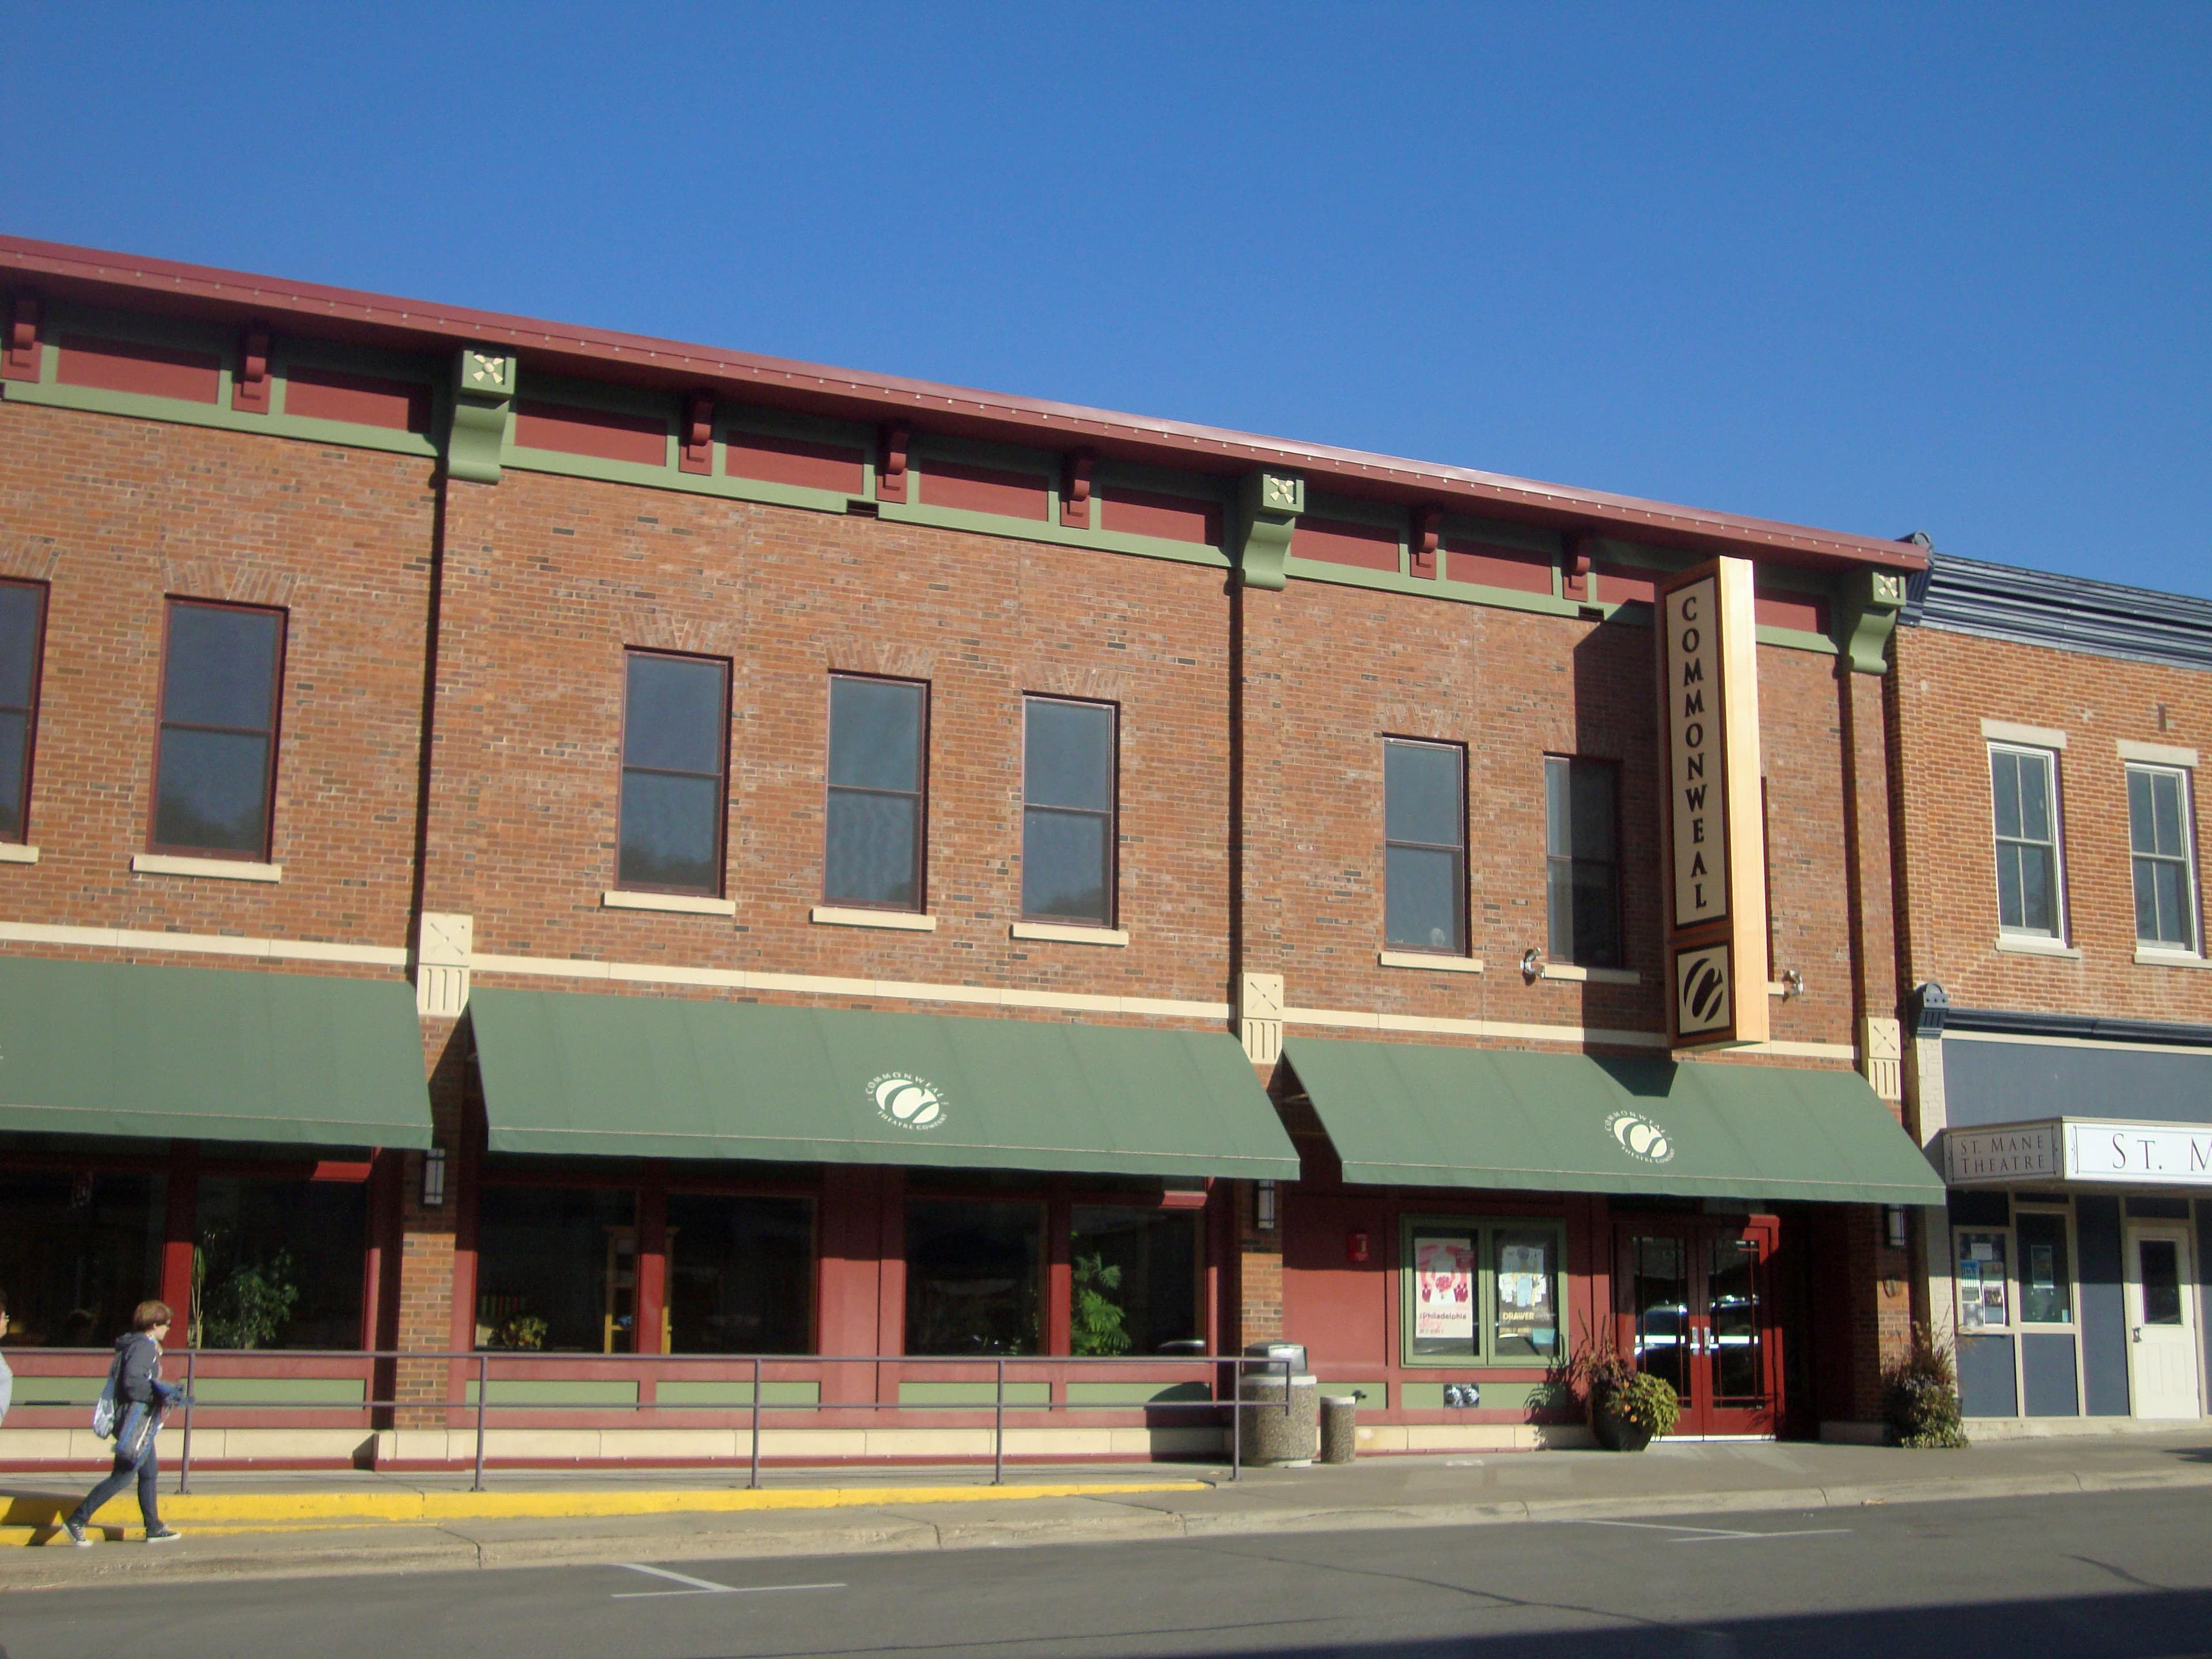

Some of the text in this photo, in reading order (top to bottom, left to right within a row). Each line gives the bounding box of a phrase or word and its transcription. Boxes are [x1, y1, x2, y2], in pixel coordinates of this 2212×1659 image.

[1681, 596, 1709, 910] COMMONWEAL
[1991, 1133, 2043, 1153] MANE
[2112, 1133, 2162, 1170] ST.
[1961, 1154, 2044, 1173] THEATRE
[1502, 1312, 1535, 1320] DRAWER
